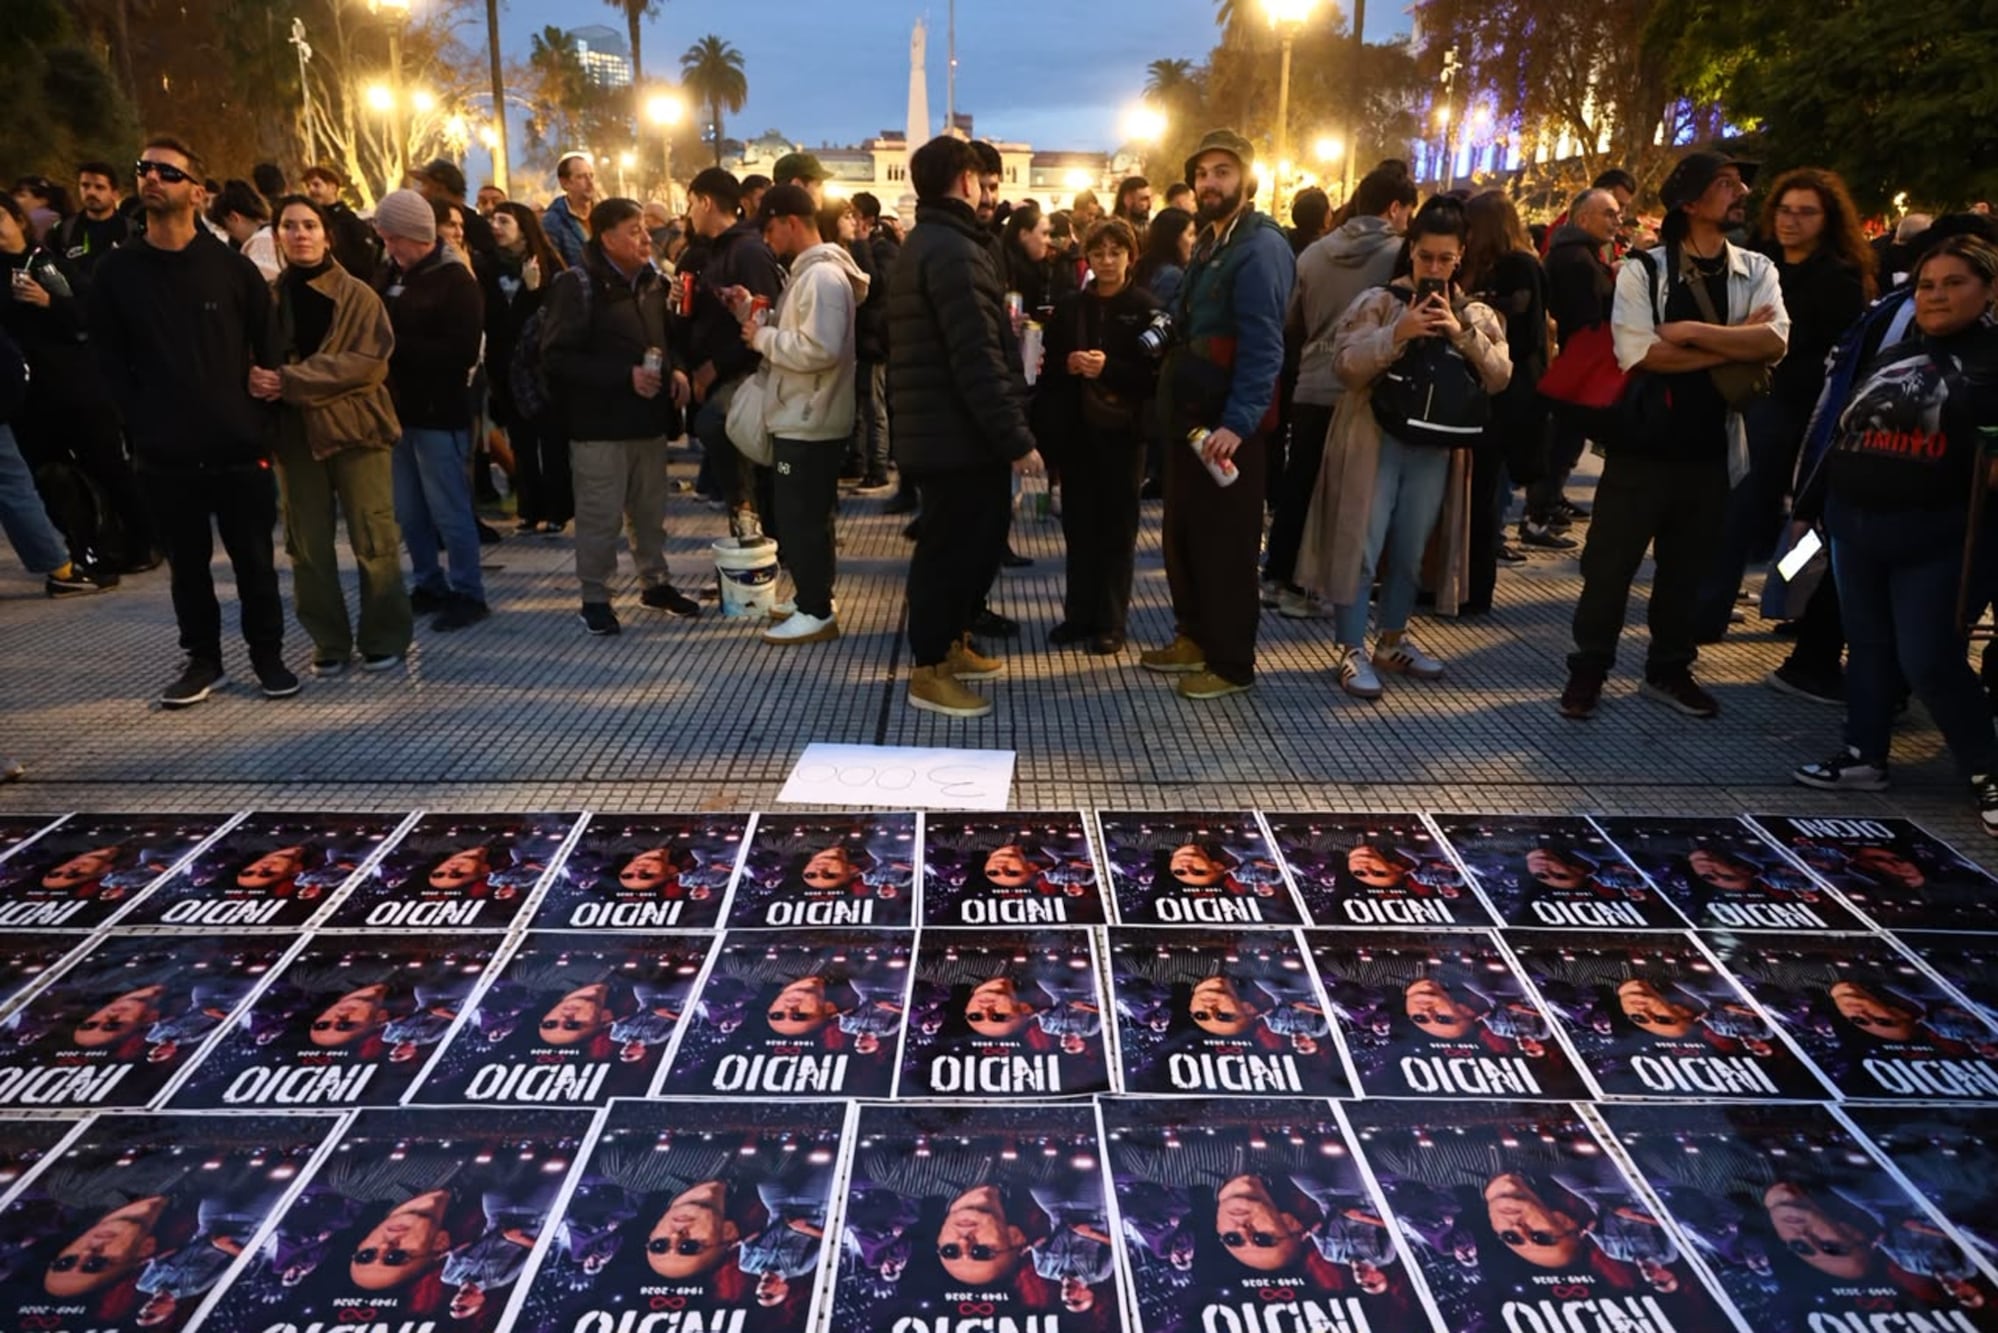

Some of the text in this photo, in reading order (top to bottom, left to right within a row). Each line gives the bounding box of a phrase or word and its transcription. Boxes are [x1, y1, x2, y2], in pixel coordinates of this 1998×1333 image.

[796, 763, 987, 798] 3000
[1788, 819, 1895, 838] INDIO
[0, 900, 88, 925] INDI
[160, 900, 288, 925] INDIO
[365, 900, 487, 926] INDIO
[569, 901, 684, 926] INDIO
[766, 899, 874, 925] INDIO
[961, 897, 1067, 924] INDIO
[1155, 896, 1260, 923] INDIO
[1342, 899, 1456, 924] INDIO
[1530, 901, 1649, 926] INDIO
[1706, 902, 1828, 928] INDIO
[222, 1064, 378, 1103] INDIO
[464, 1063, 611, 1102] INDIO
[711, 1054, 849, 1092] INDIO
[930, 1054, 1061, 1093] INDIO
[1168, 1053, 1303, 1092] INDIO
[1399, 1056, 1543, 1095] INDIO
[1630, 1056, 1779, 1095] INDIO
[639, 1286, 669, 1296] 2026
[675, 1286, 704, 1296] 1949
[1241, 1278, 1270, 1288] 2026
[1277, 1277, 1305, 1287] 1949
[944, 1292, 973, 1302] 2026
[980, 1292, 1009, 1302] 1949
